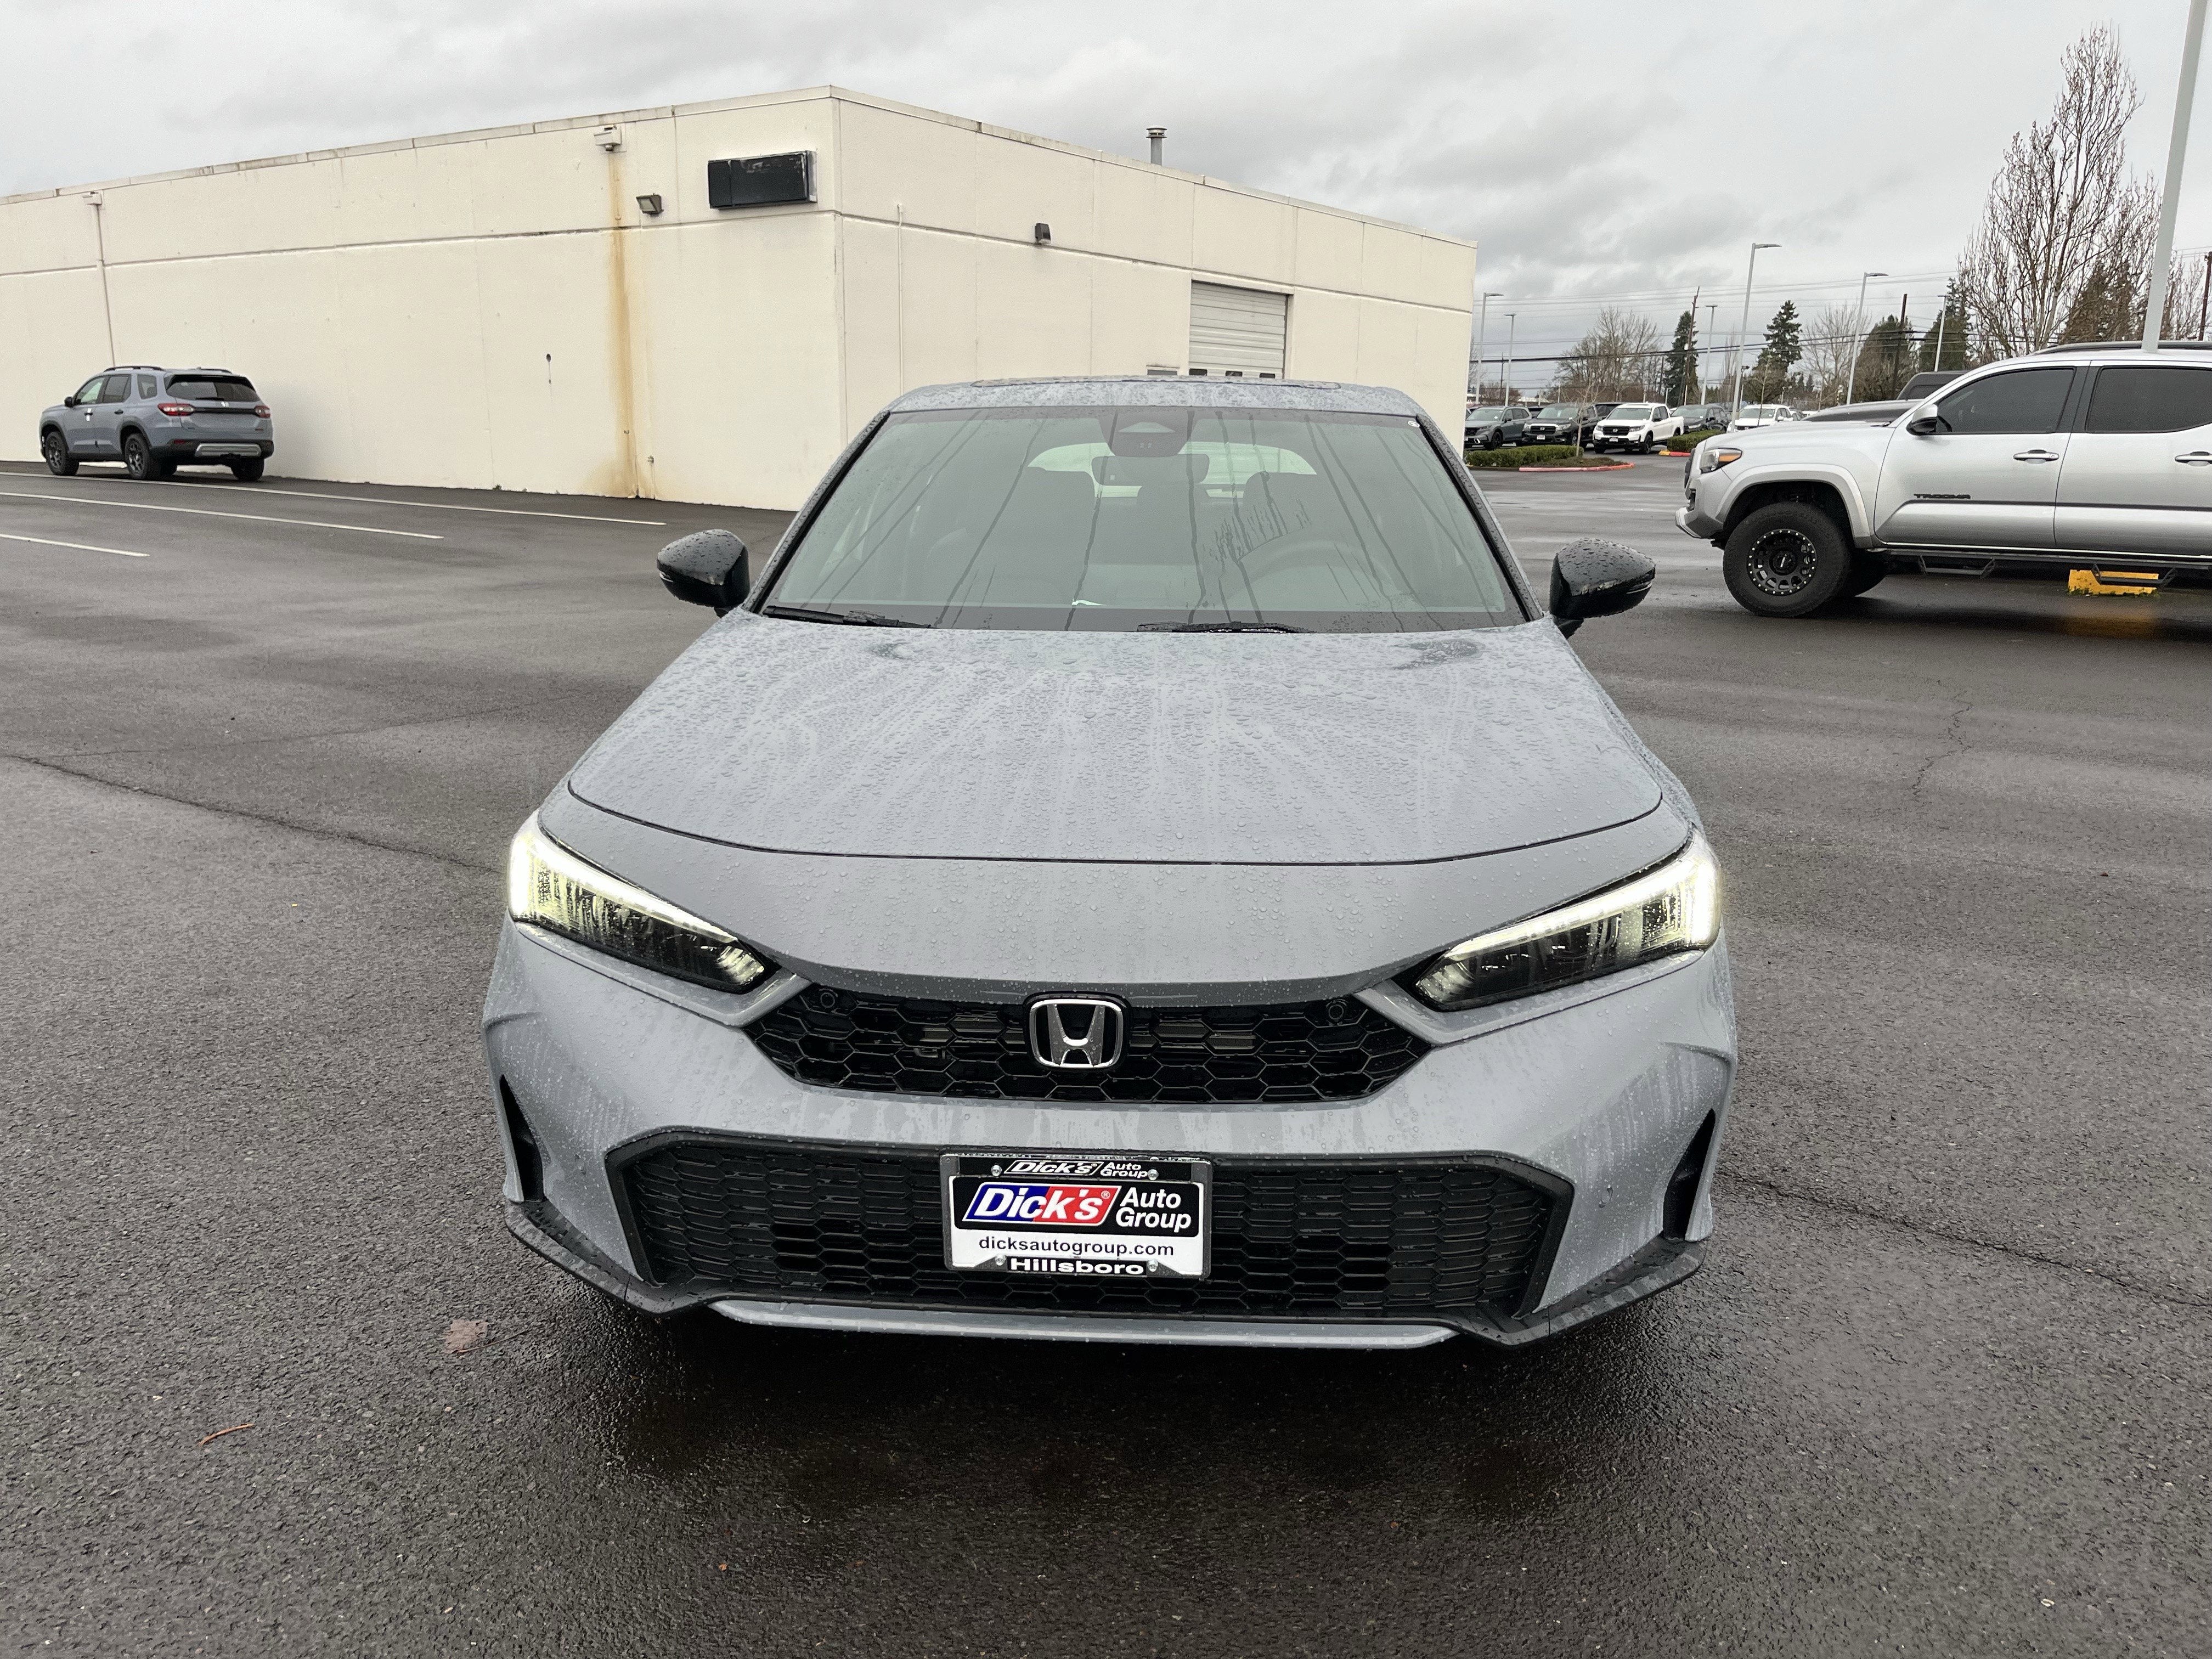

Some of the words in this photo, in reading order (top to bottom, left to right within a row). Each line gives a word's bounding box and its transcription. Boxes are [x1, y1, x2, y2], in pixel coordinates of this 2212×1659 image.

[1011, 1161, 1093, 1174] Dick's
[1103, 1162, 1142, 1170] Auto
[1100, 1169, 1148, 1178] Group
[974, 1187, 1102, 1220] Dick's
[1120, 1187, 1181, 1209] Auto
[1116, 1207, 1191, 1232] Group
[979, 1236, 1174, 1256] dicksautogroup.com
[1011, 1258, 1144, 1274] Hillsboro
